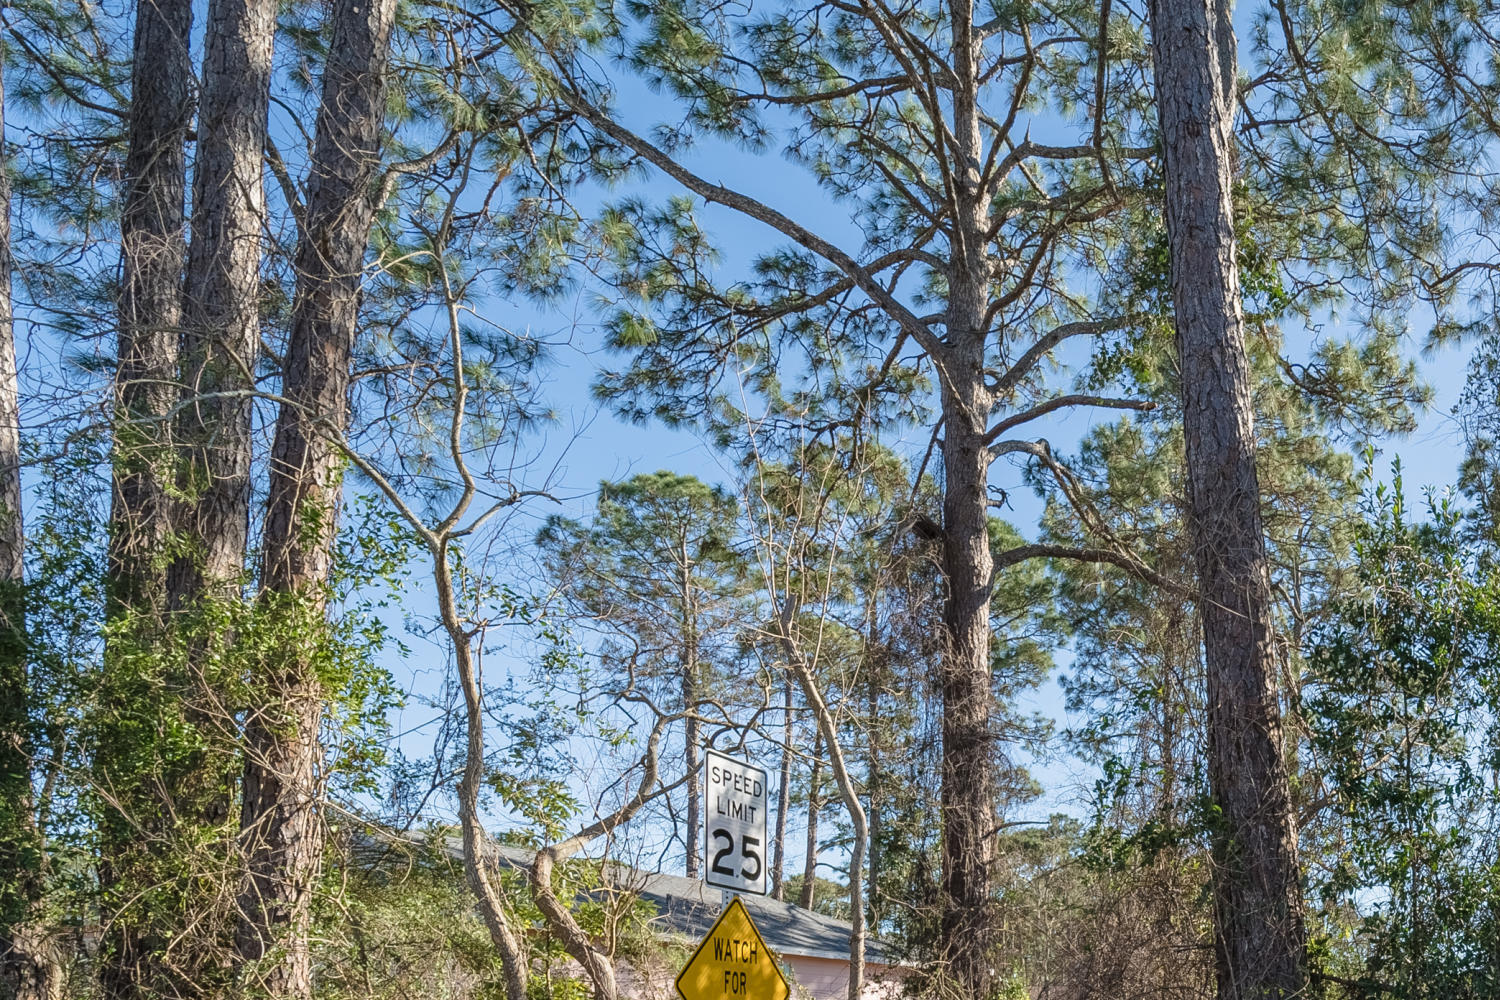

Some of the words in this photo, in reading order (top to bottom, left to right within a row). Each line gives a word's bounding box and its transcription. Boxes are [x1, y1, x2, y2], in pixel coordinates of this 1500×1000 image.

[711, 766, 763, 798] SPEED
[716, 795, 757, 824] LIMIT
[711, 828, 762, 881] 25
[713, 936, 758, 964] WATCH
[724, 970, 747, 995] FOR
